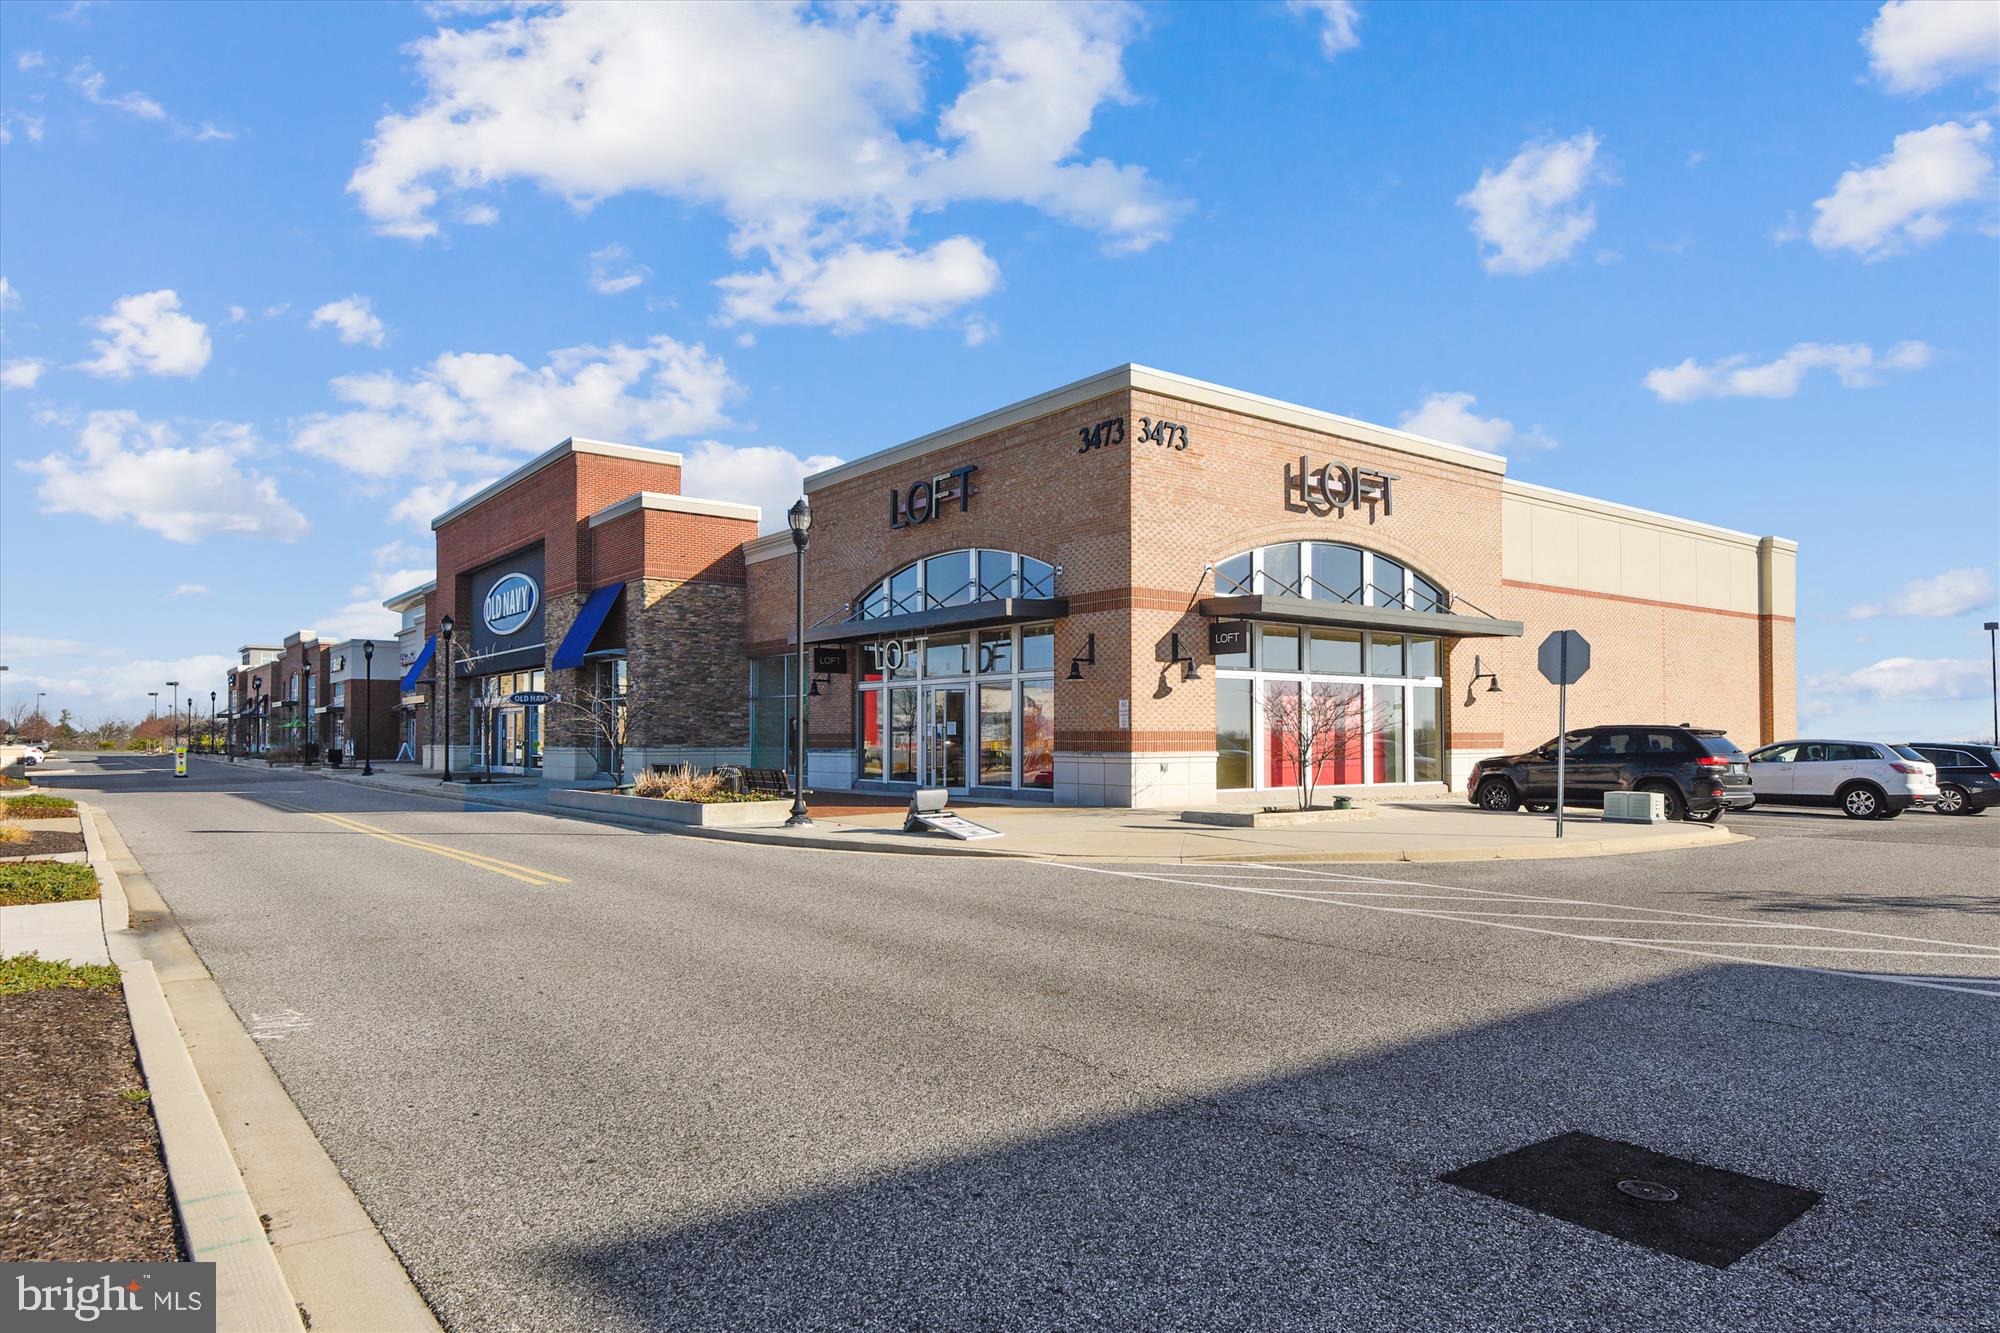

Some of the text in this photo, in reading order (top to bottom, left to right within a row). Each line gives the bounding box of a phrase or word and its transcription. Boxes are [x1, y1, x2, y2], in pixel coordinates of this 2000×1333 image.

[1078, 417, 1125, 453] 3473
[1137, 417, 1188, 451] 3473
[890, 464, 978, 529] LOFT
[1300, 455, 1401, 516] LOFT
[485, 585, 530, 621] OLD NAVY
[874, 636, 929, 669] LOFT
[1215, 632, 1240, 644] LOFT
[819, 656, 841, 665] LOFT
